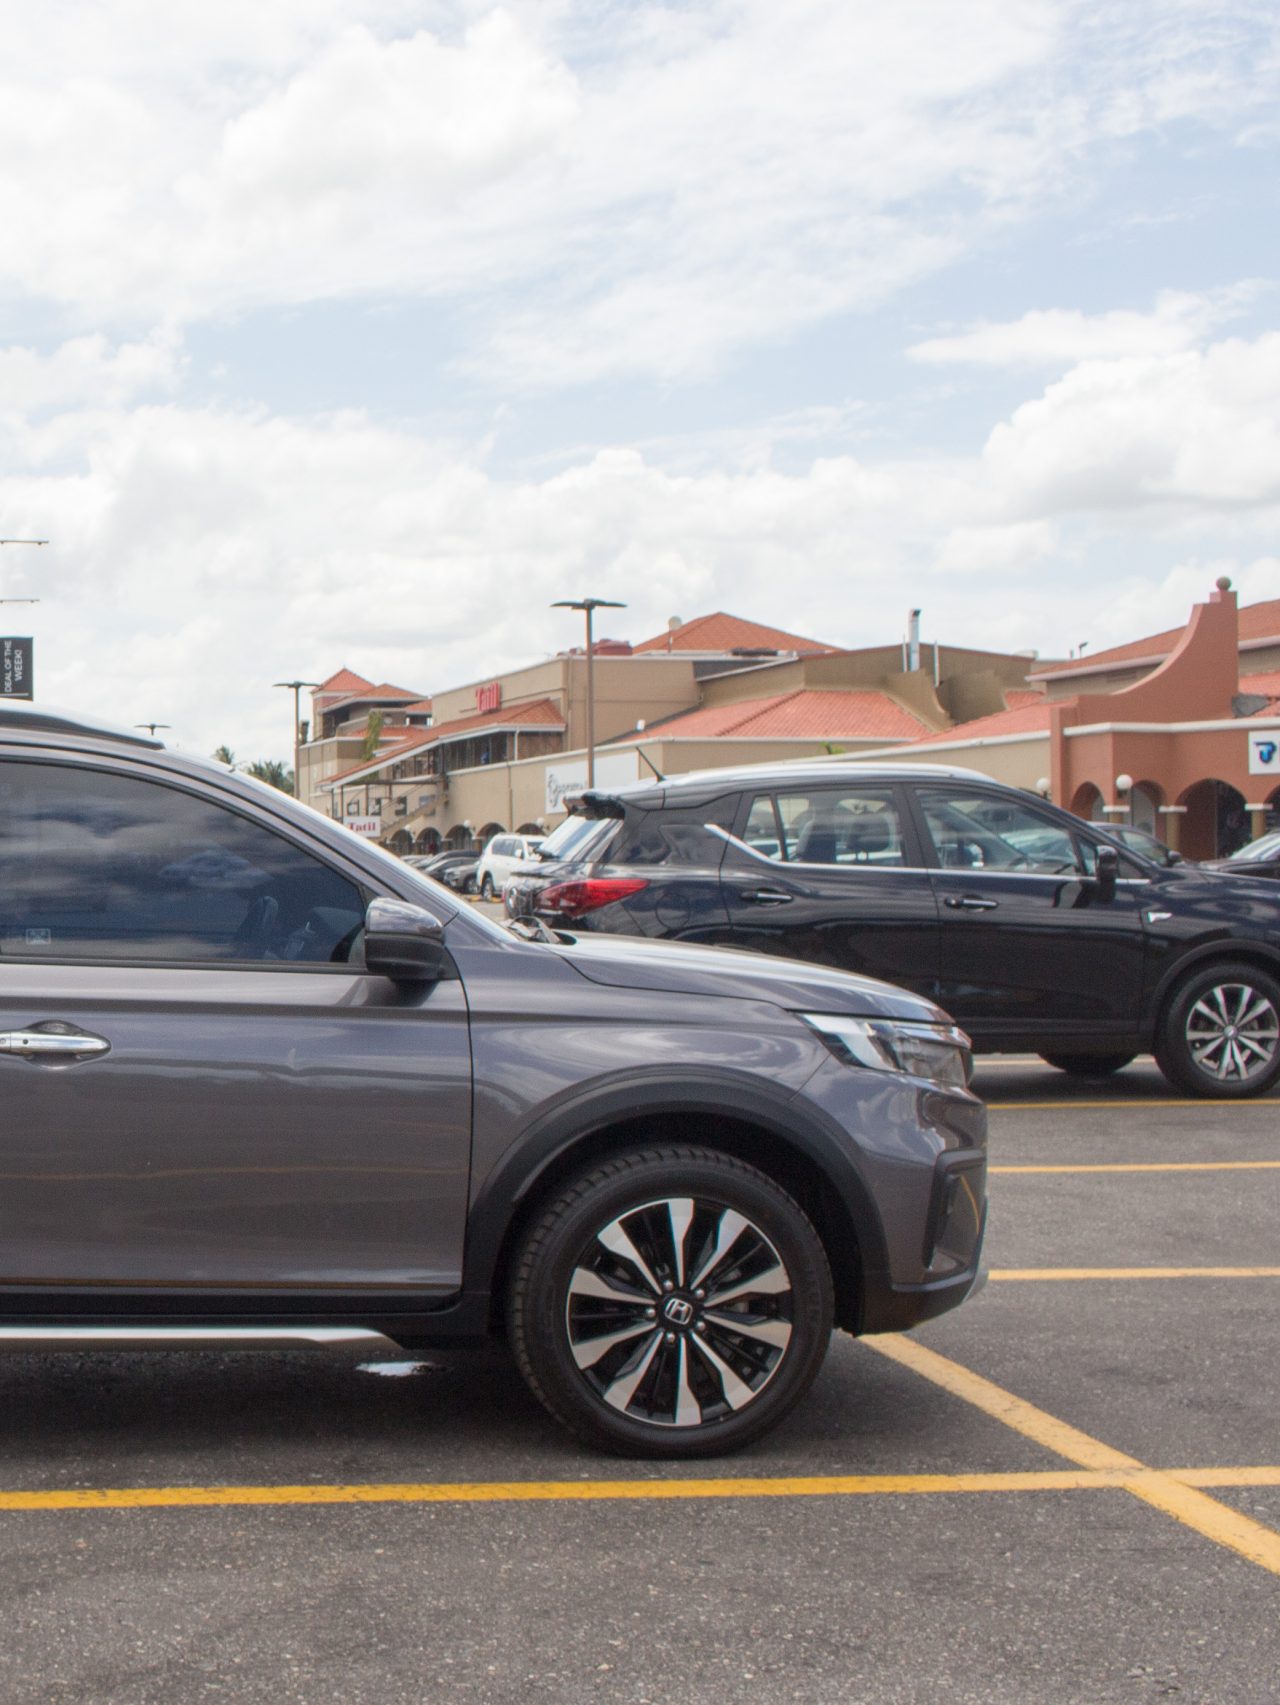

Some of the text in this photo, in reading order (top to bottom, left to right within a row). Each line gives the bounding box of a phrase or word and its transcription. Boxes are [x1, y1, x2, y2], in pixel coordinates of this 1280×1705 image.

[4, 640, 12, 693] DEAL OF THE
